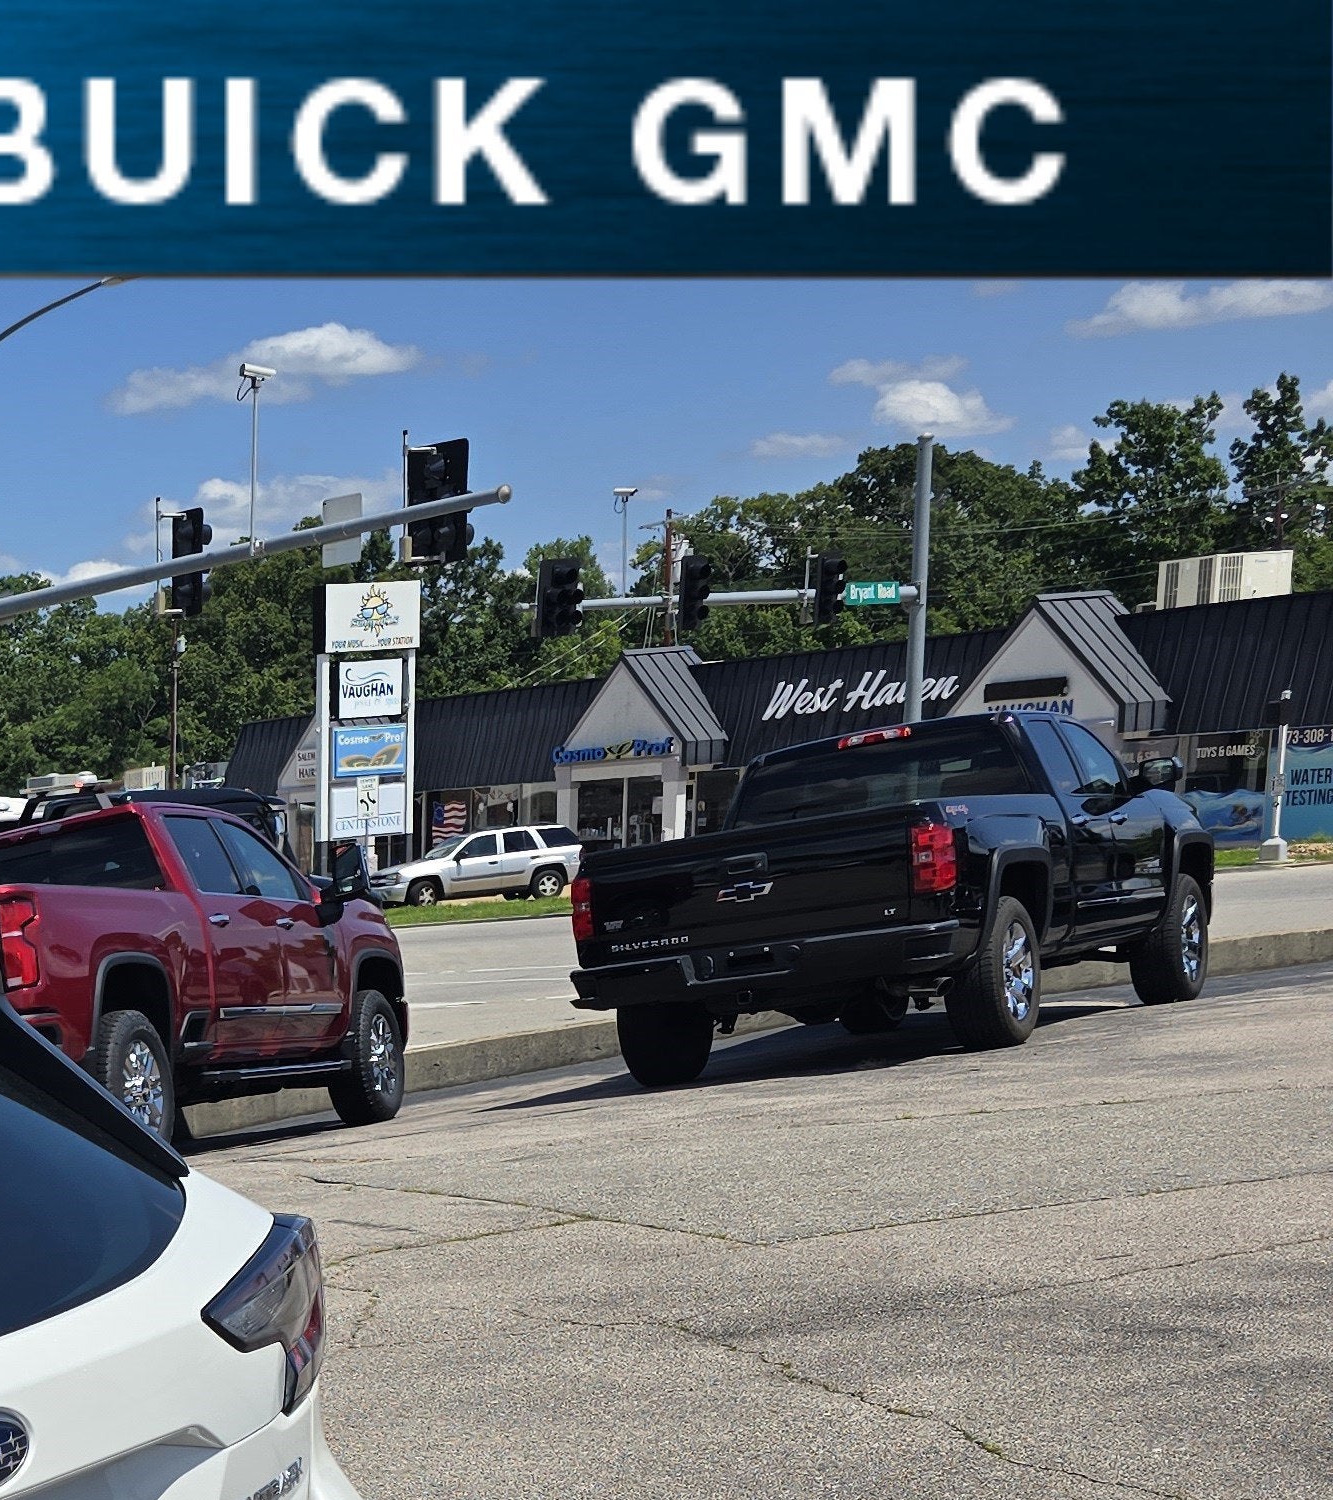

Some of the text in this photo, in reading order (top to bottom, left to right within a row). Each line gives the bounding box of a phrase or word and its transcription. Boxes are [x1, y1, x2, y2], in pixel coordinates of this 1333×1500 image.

[850, 584, 875, 603] Bryant
[341, 682, 394, 699] VAUGHAN
[762, 678, 845, 721] West
[338, 731, 404, 746] Cosmo Prof
[552, 736, 675, 765] Cosmo Prof
[1196, 744, 1256, 759] TOYS & GAMES
[1290, 767, 1332, 786] WATER
[1285, 788, 1333, 807] TESTING
[884, 907, 897, 917] LT
[611, 935, 689, 953] SILVERADO
